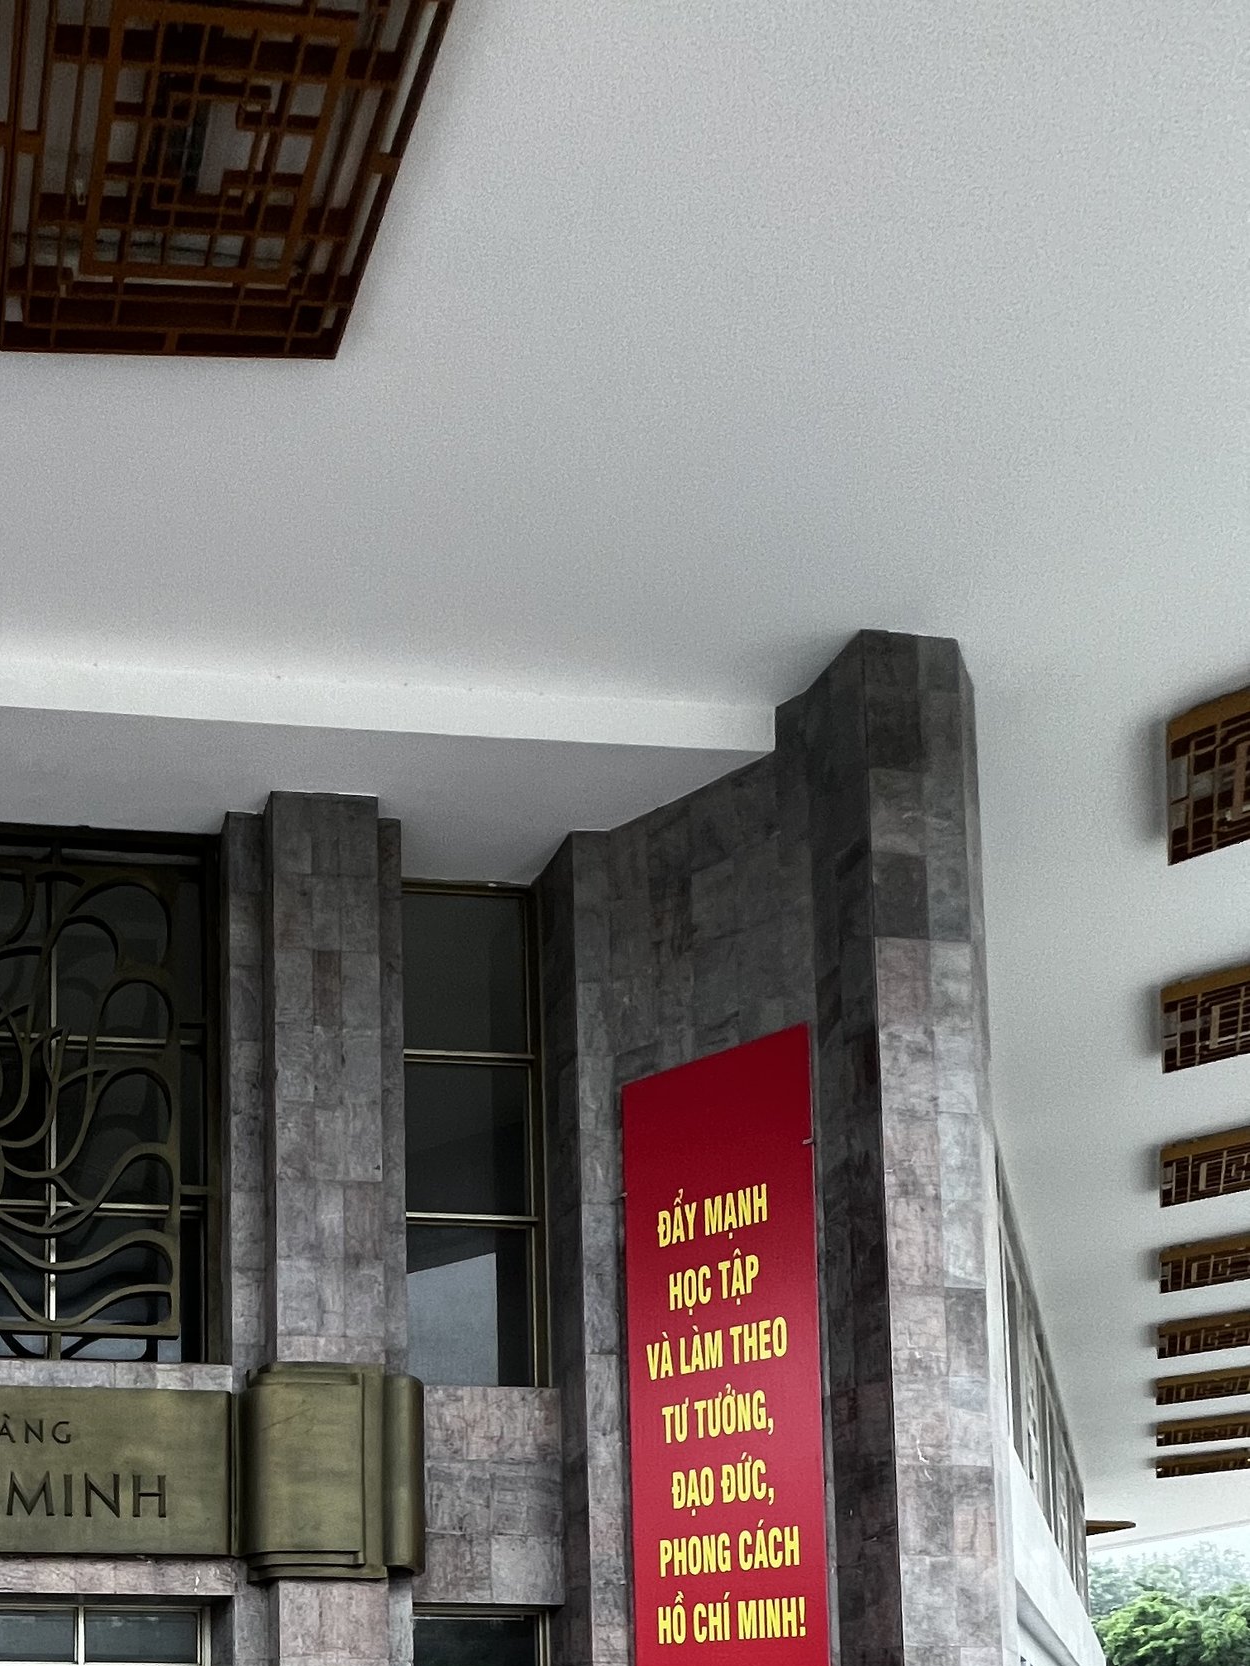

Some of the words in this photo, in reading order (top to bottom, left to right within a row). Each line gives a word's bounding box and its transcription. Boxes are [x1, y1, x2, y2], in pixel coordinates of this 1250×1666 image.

[658, 1188, 696, 1247] ĐẨY
[705, 1183, 767, 1239] MẠNH
[669, 1262, 711, 1315] HỌC
[718, 1248, 759, 1305] TẬP
[646, 1331, 674, 1380] VÀ
[680, 1325, 723, 1374] LÀM
[729, 1316, 788, 1365] THEO
[662, 1397, 689, 1443] TƯ
[694, 1383, 774, 1439] TƯỞNG,
[6, 1470, 167, 1518] MINH
[671, 1467, 714, 1516] ĐẠO
[721, 1451, 774, 1505] ĐỨC,
[660, 1533, 731, 1577] PHONG
[739, 1519, 800, 1570] CÁCH
[658, 1590, 686, 1644] HỒ
[693, 1592, 730, 1643] CHÍ
[738, 1597, 806, 1639] MINH!
